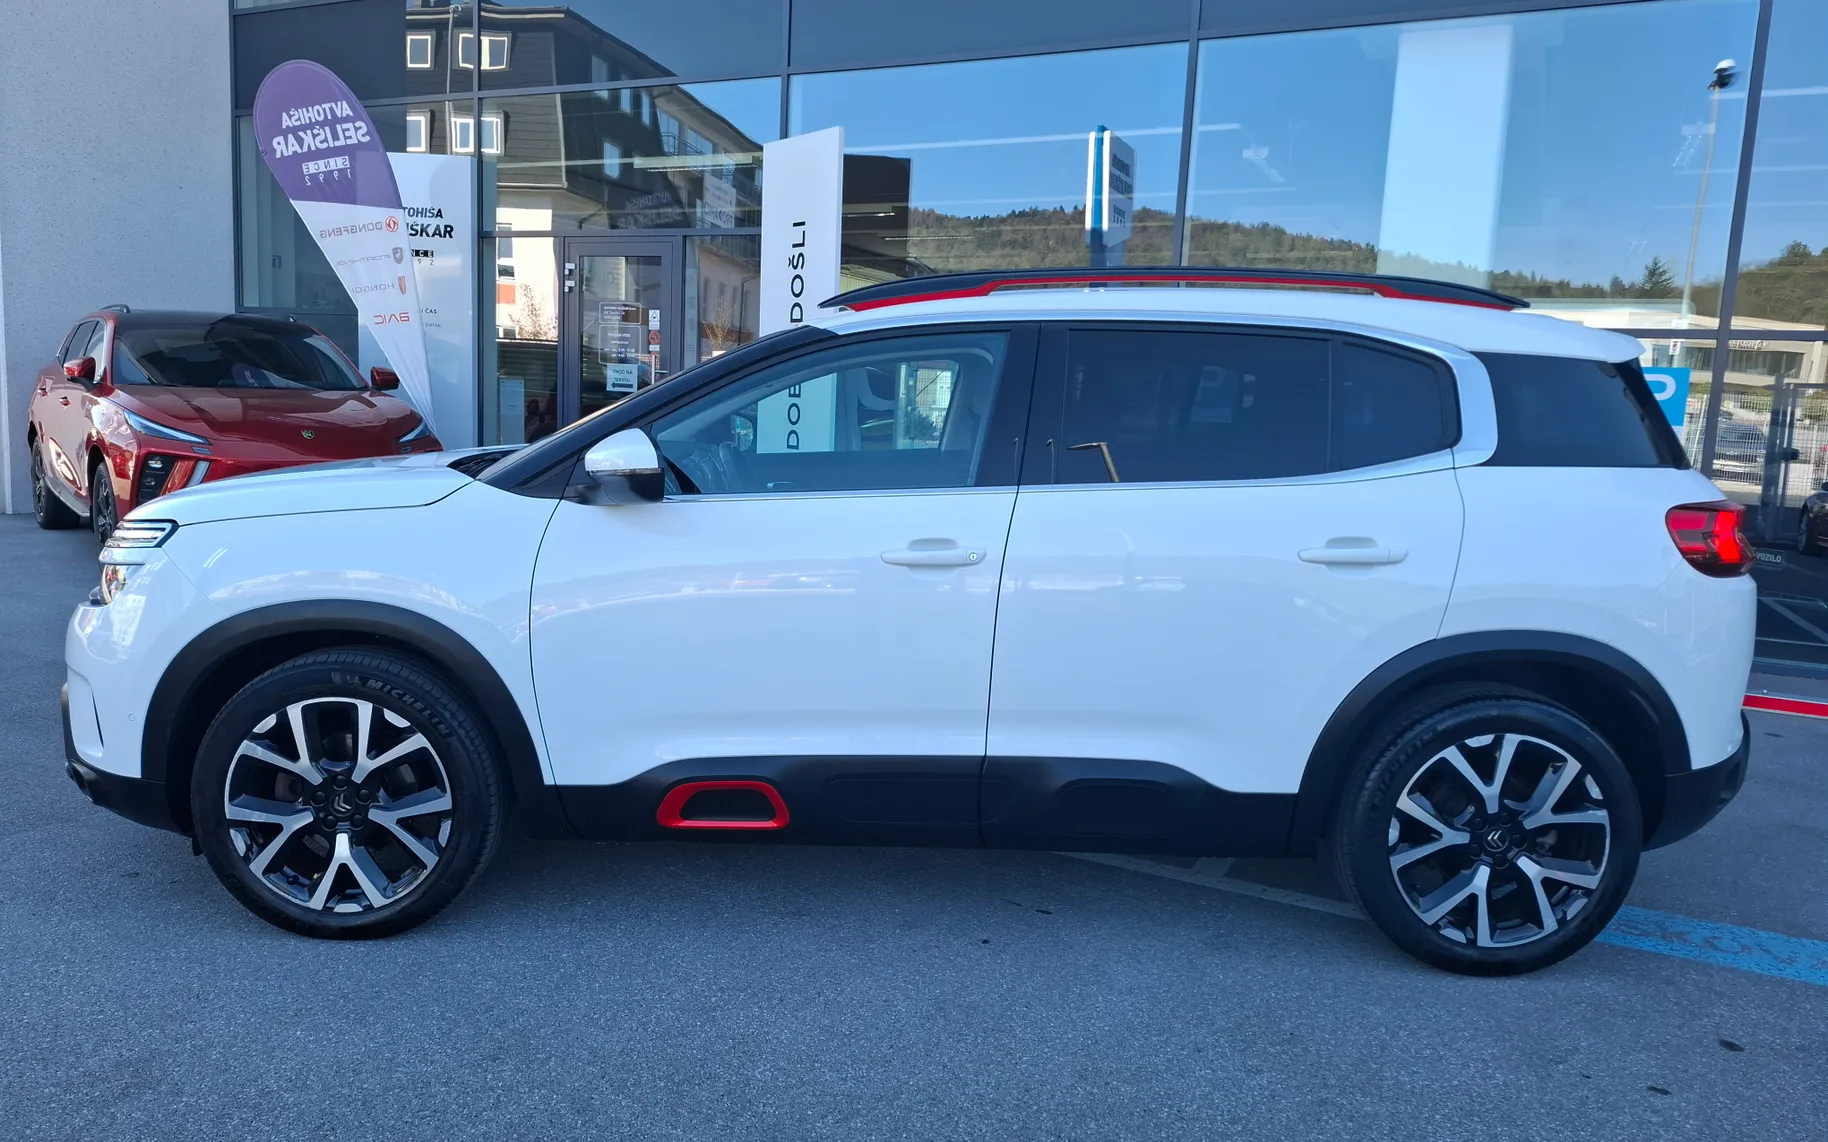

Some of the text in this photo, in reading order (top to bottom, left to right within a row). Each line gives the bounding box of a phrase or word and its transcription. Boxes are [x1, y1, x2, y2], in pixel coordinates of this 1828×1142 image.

[404, 206, 444, 219] TOHIŠA
[407, 221, 454, 239] IŠKAR
[411, 249, 434, 258] NCE
[417, 258, 434, 266] 92
[1756, 552, 1782, 563] VOZILO
[366, 679, 450, 735] MICHELIN
